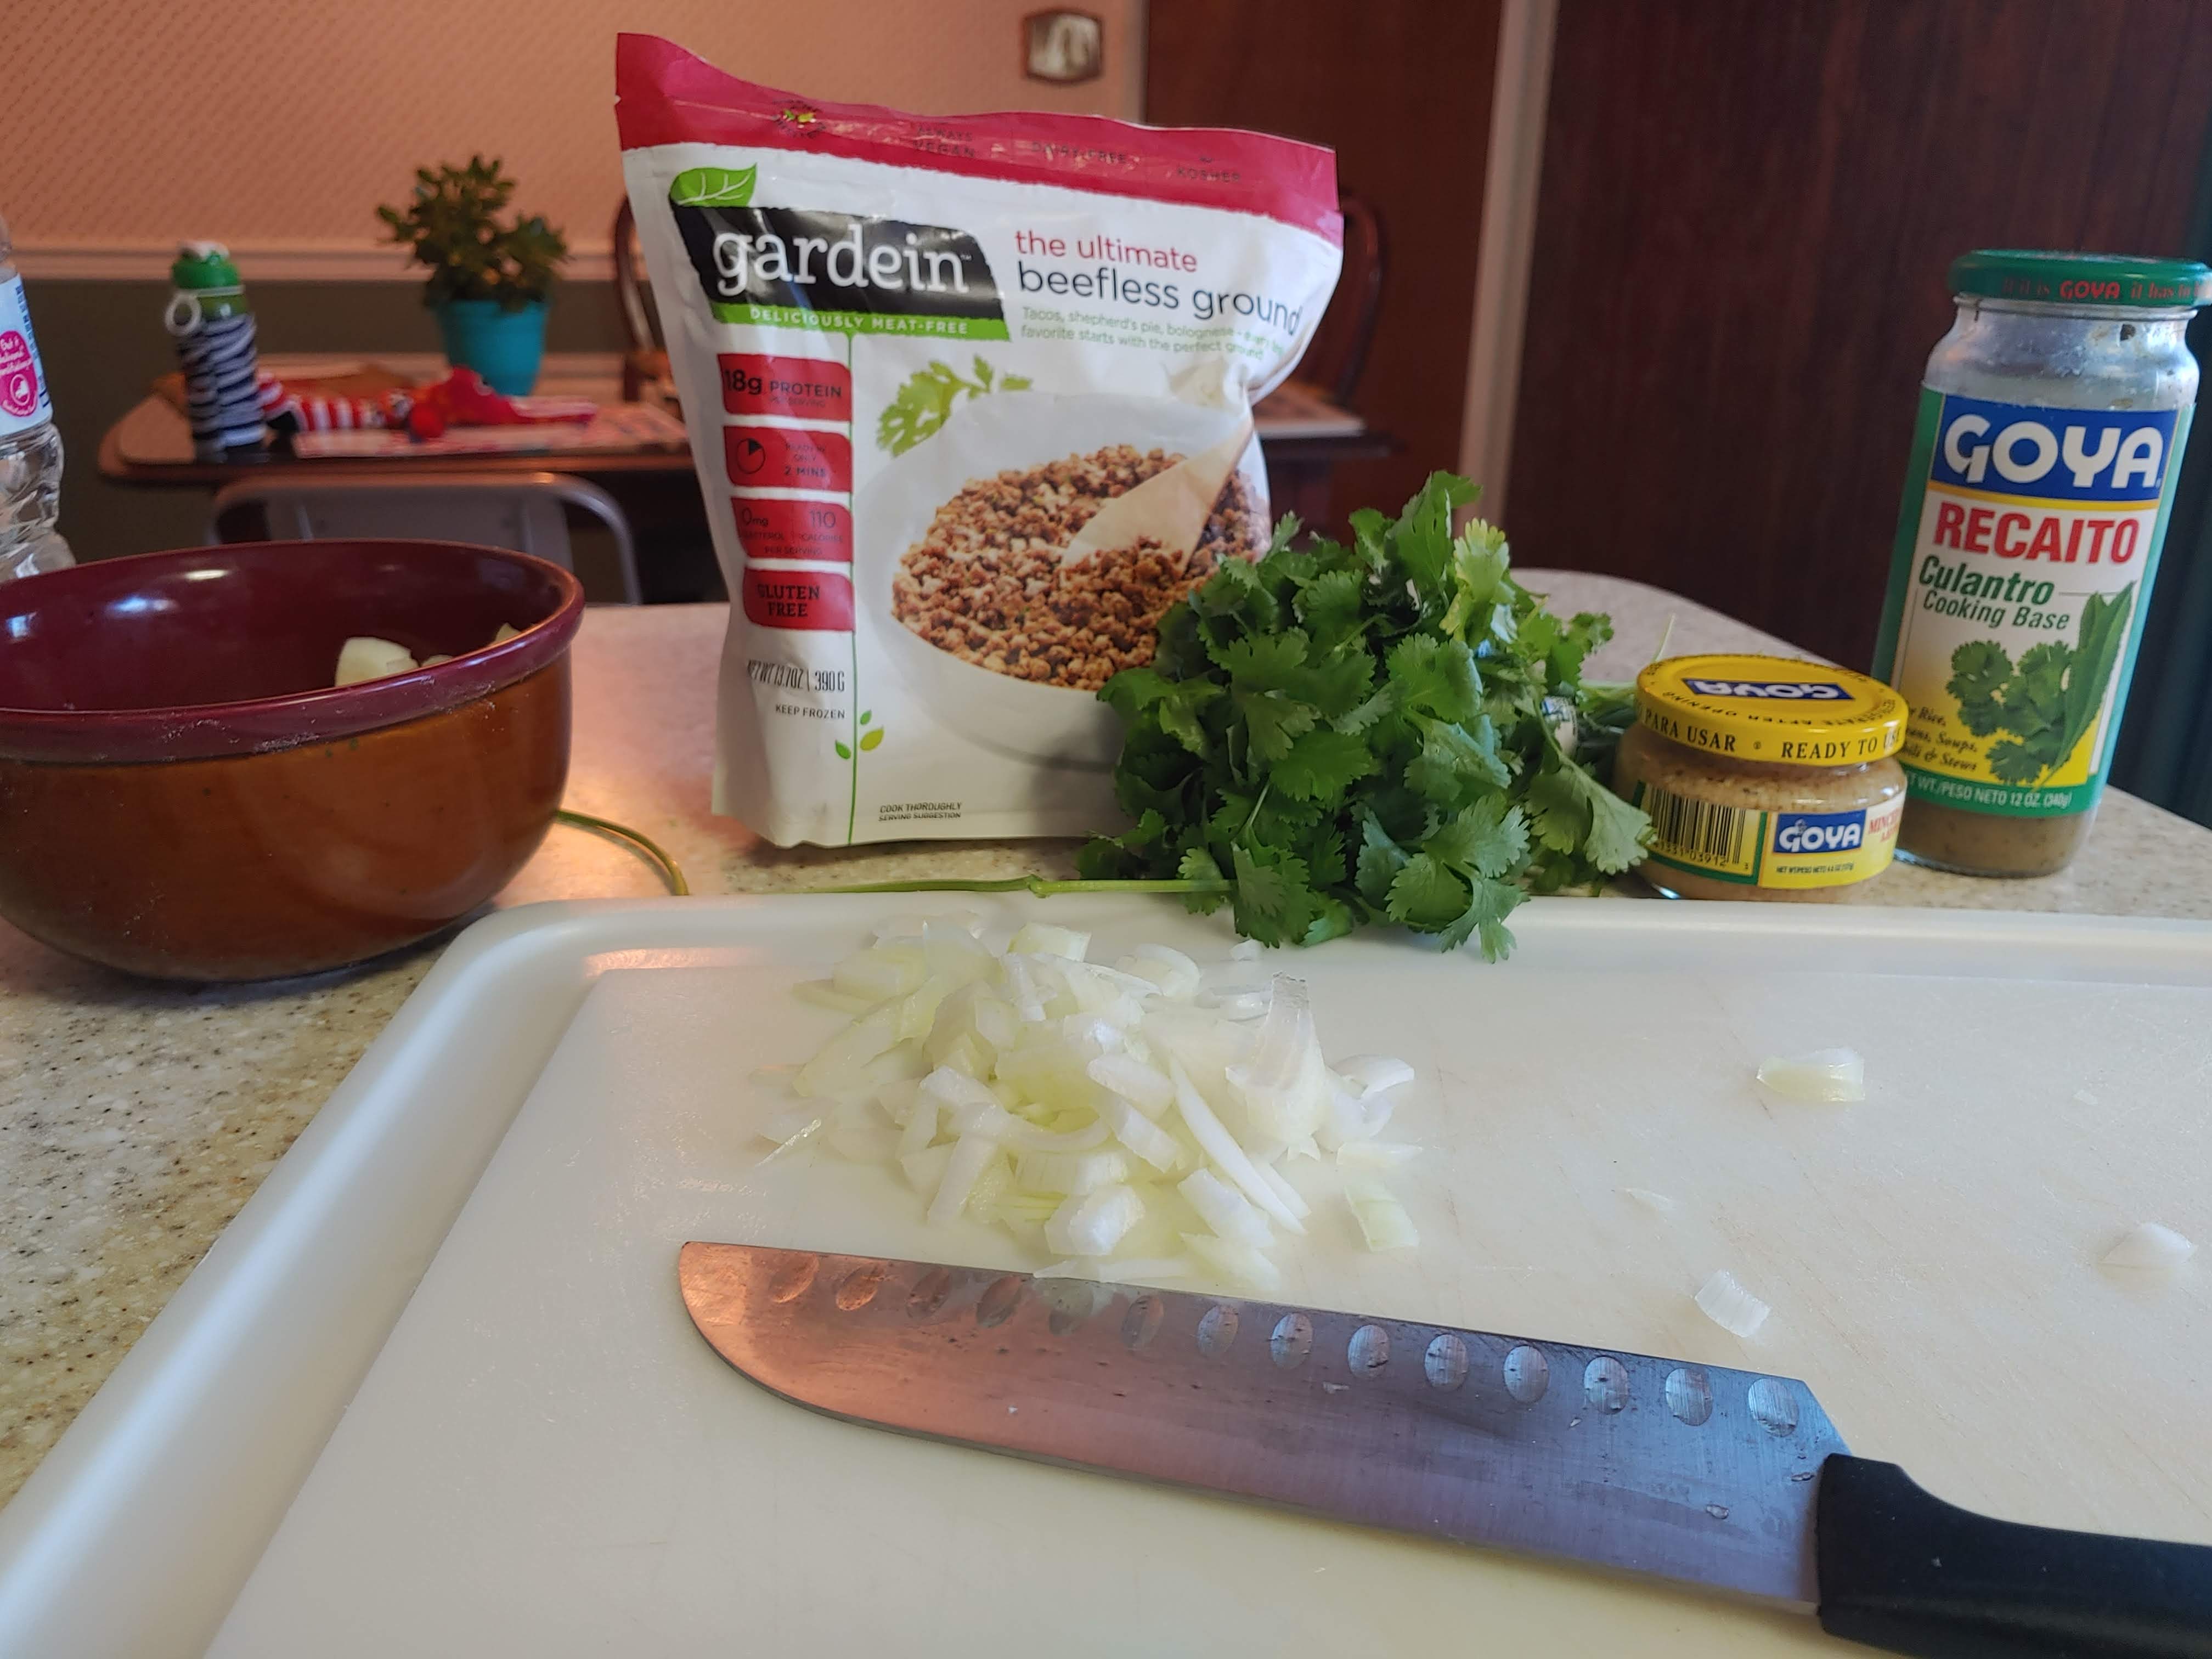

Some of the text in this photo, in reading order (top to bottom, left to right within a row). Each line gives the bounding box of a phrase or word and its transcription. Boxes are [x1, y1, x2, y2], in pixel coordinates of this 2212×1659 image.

[913, 139, 975, 158] VEGAN
[713, 223, 970, 296] gardein
[1015, 230, 1198, 273] the ultimate
[1018, 261, 1304, 336] beefless ground
[2058, 280, 2121, 300] GOYA
[749, 305, 968, 334] DELICIOUSLY MEAT-FREE
[724, 368, 842, 398] 18g PROTEIN
[1944, 413, 2164, 488] GOYA
[809, 509, 837, 528] 110
[1933, 500, 2141, 566] RECAITO
[1919, 554, 2056, 606] Culantro
[757, 583, 821, 618] GLUTEN FREE
[1923, 589, 2070, 631] Cooking Base
[814, 669, 836, 692] 390
[837, 669, 845, 692] G
[1692, 679, 1839, 699] GOYA
[775, 704, 845, 720] KEEP FROZEN
[1645, 707, 1679, 738] PARA
[1686, 725, 1737, 752] USAR
[1781, 740, 1852, 760] READY
[1858, 736, 1878, 757] TO
[879, 802, 962, 813] COOK THOROUGHLY
[1974, 786, 2008, 806] NETO
[2010, 791, 2022, 808] 12
[878, 812, 912, 822] SERVING
[1779, 822, 1861, 853] GOYA
